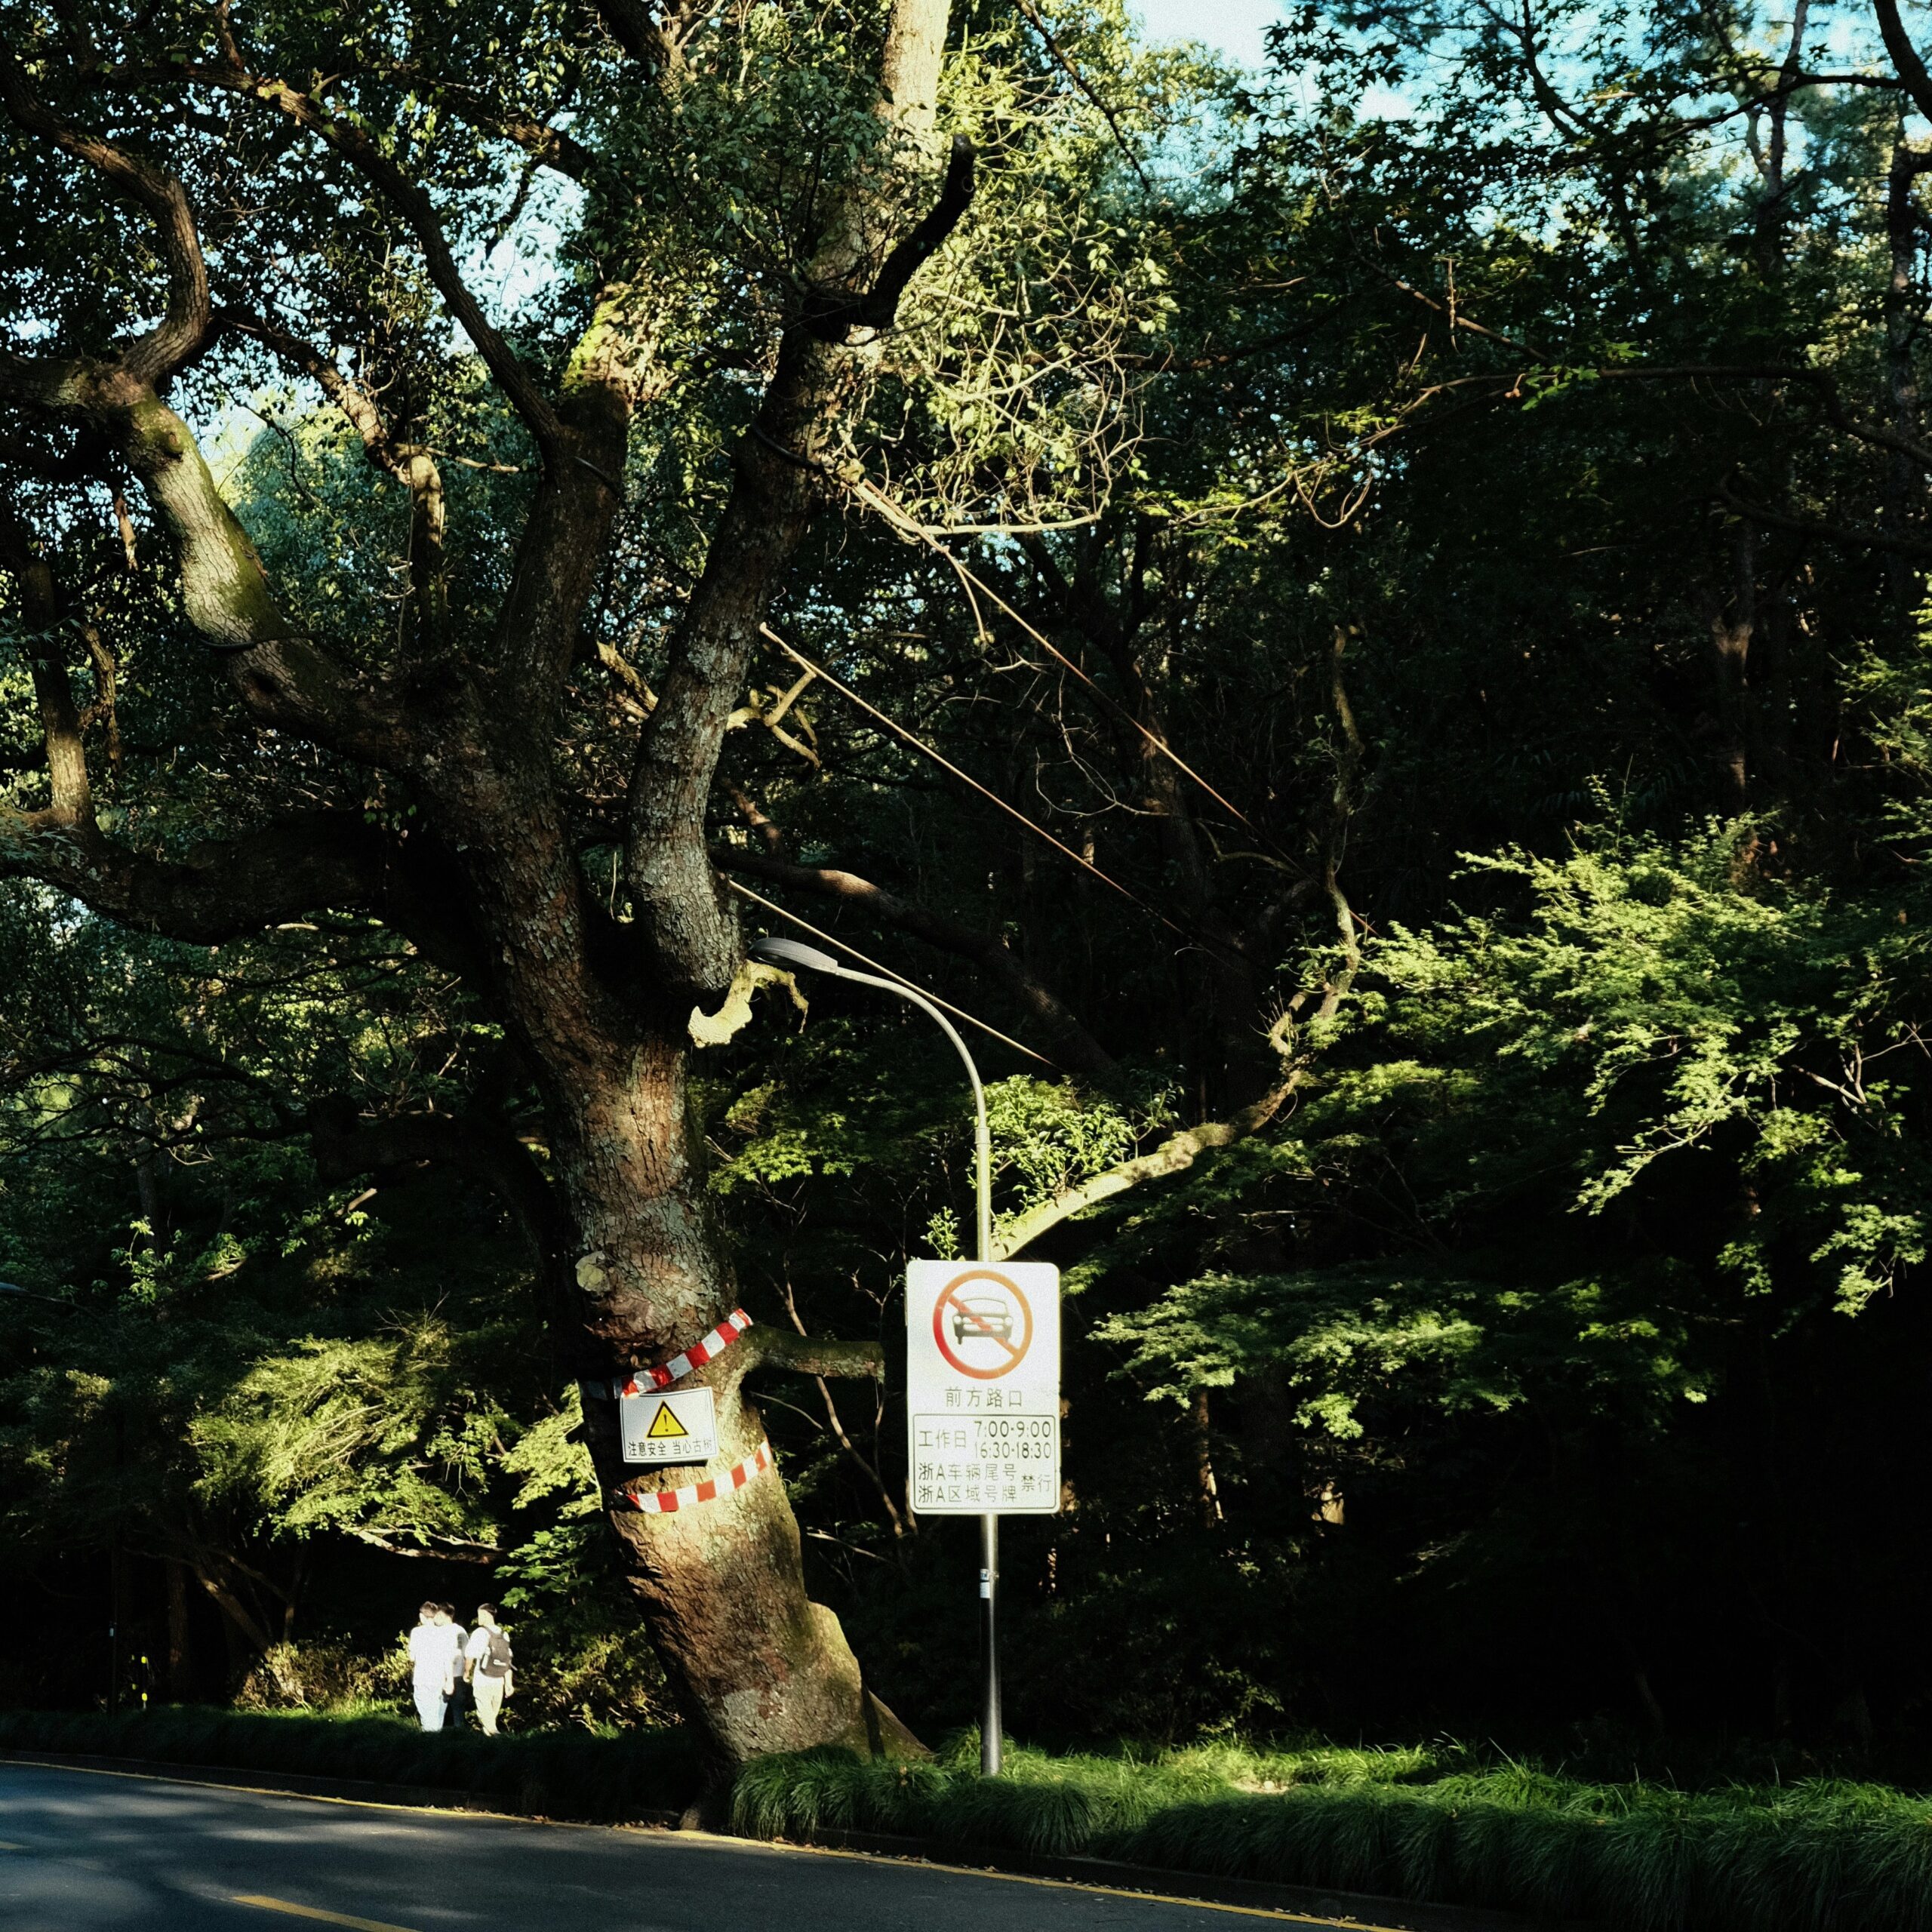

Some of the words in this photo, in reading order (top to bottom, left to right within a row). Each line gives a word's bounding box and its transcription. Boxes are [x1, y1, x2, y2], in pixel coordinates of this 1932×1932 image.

[944, 1386, 1022, 1407] 前方路口
[918, 1429, 966, 1448] 工作日
[629, 1441, 666, 1456] 注意安全
[1021, 1474, 1051, 1492] 禁行
